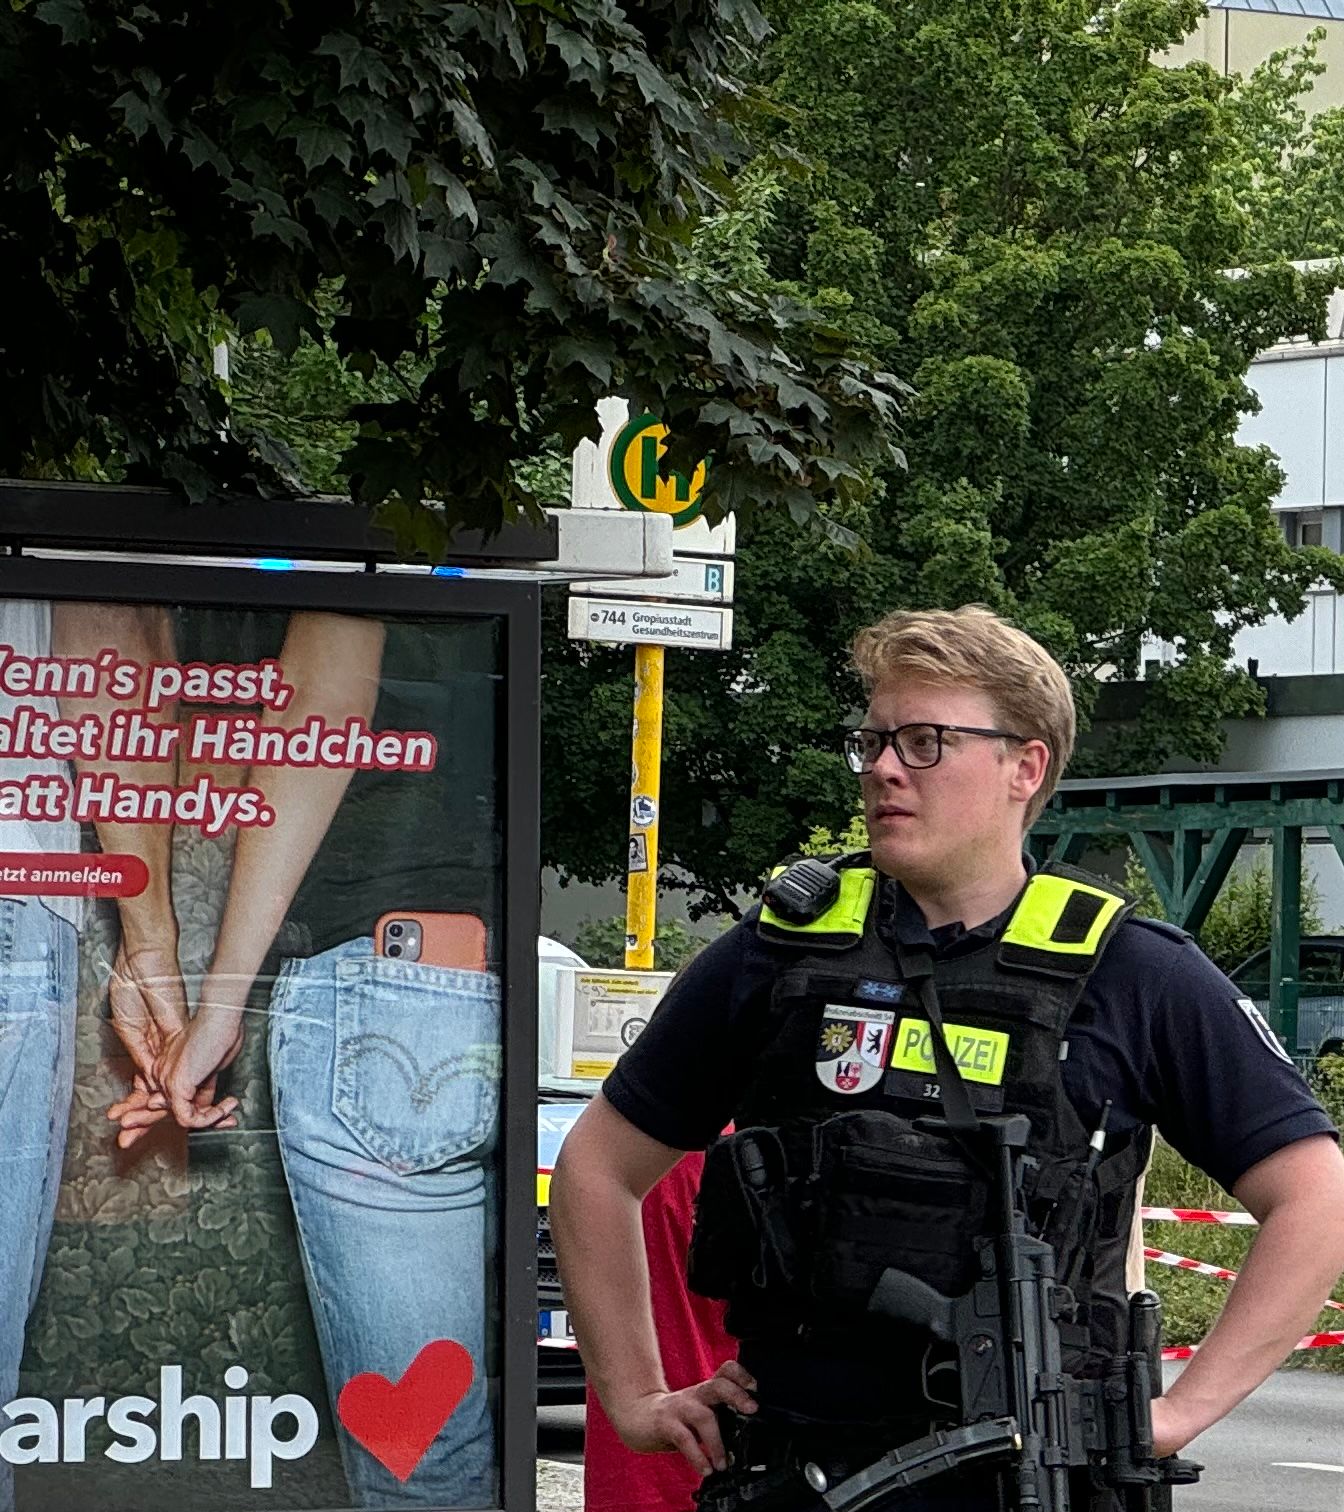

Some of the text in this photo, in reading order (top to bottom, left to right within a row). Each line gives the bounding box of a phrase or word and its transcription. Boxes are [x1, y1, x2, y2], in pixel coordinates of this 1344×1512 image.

[708, 567, 720, 592] B
[601, 609, 626, 625] 744
[632, 625, 719, 640] Gesundheitszentrum
[0, 653, 289, 707] enn's passt,
[110, 715, 179, 757] ihr
[191, 719, 432, 766] Händchen
[77, 778, 275, 833] Handys.
[0, 866, 122, 884] tzt anmelden
[903, 1028, 999, 1073] POIZEI
[923, 1083, 941, 1098] 32
[0, 1365, 320, 1489] arship
